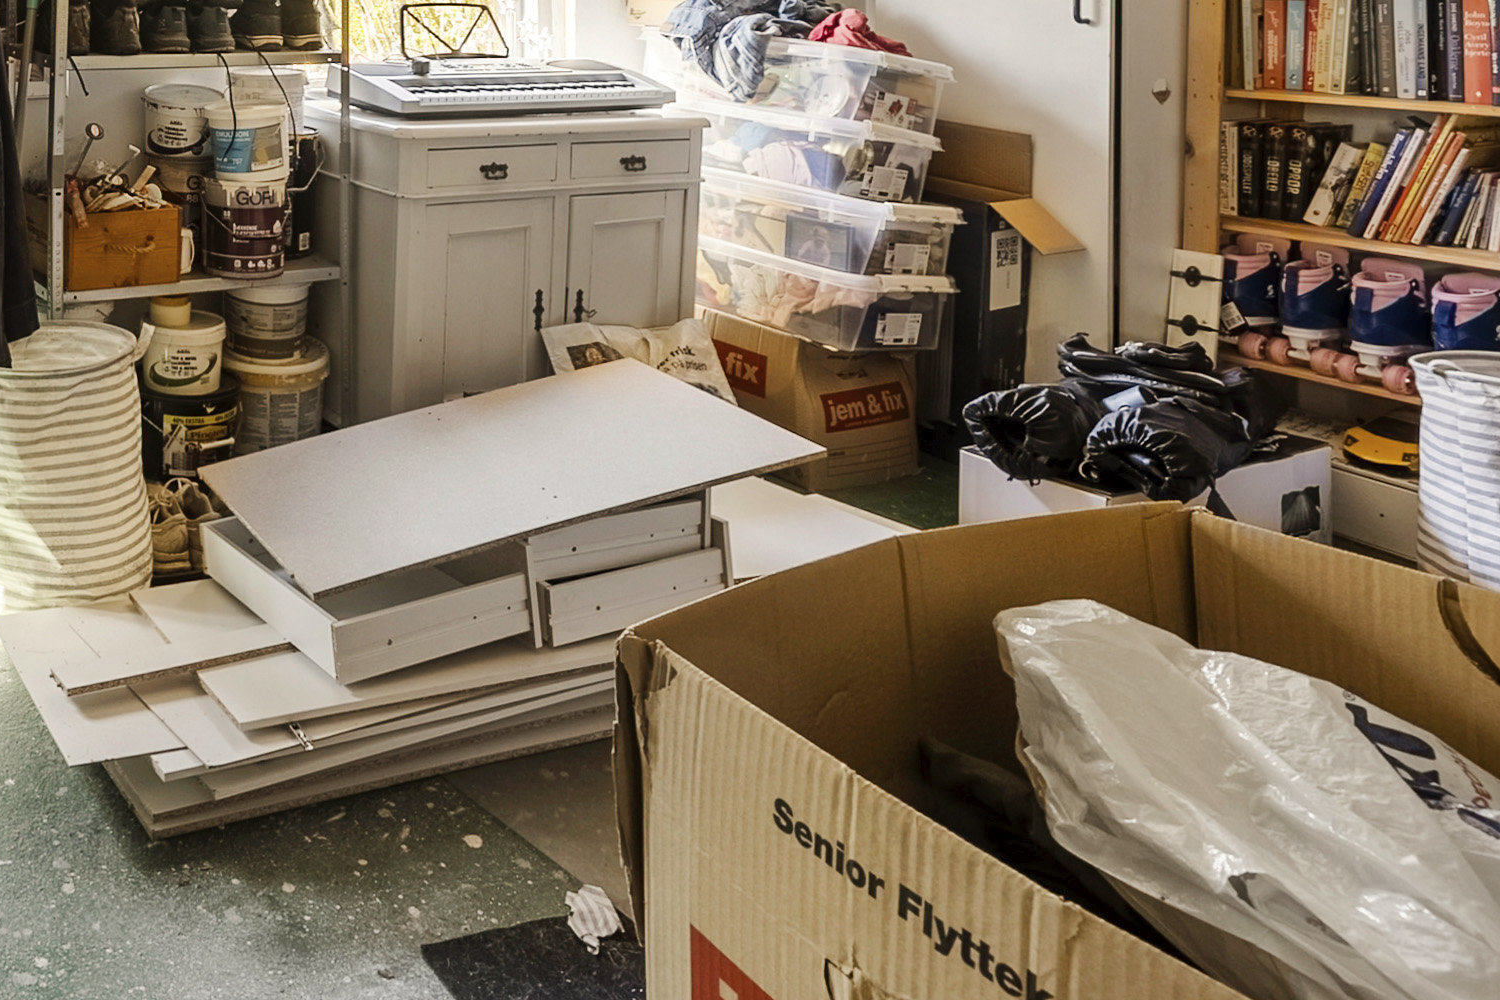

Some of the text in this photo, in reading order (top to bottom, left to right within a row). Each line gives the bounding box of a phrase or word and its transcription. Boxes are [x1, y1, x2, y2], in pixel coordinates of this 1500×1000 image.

[236, 189, 276, 206] GORI
[725, 351, 759, 384] fix
[828, 400, 867, 427] jem
[866, 393, 882, 416] &
[881, 390, 905, 412] fix
[773, 797, 886, 900] Senior
